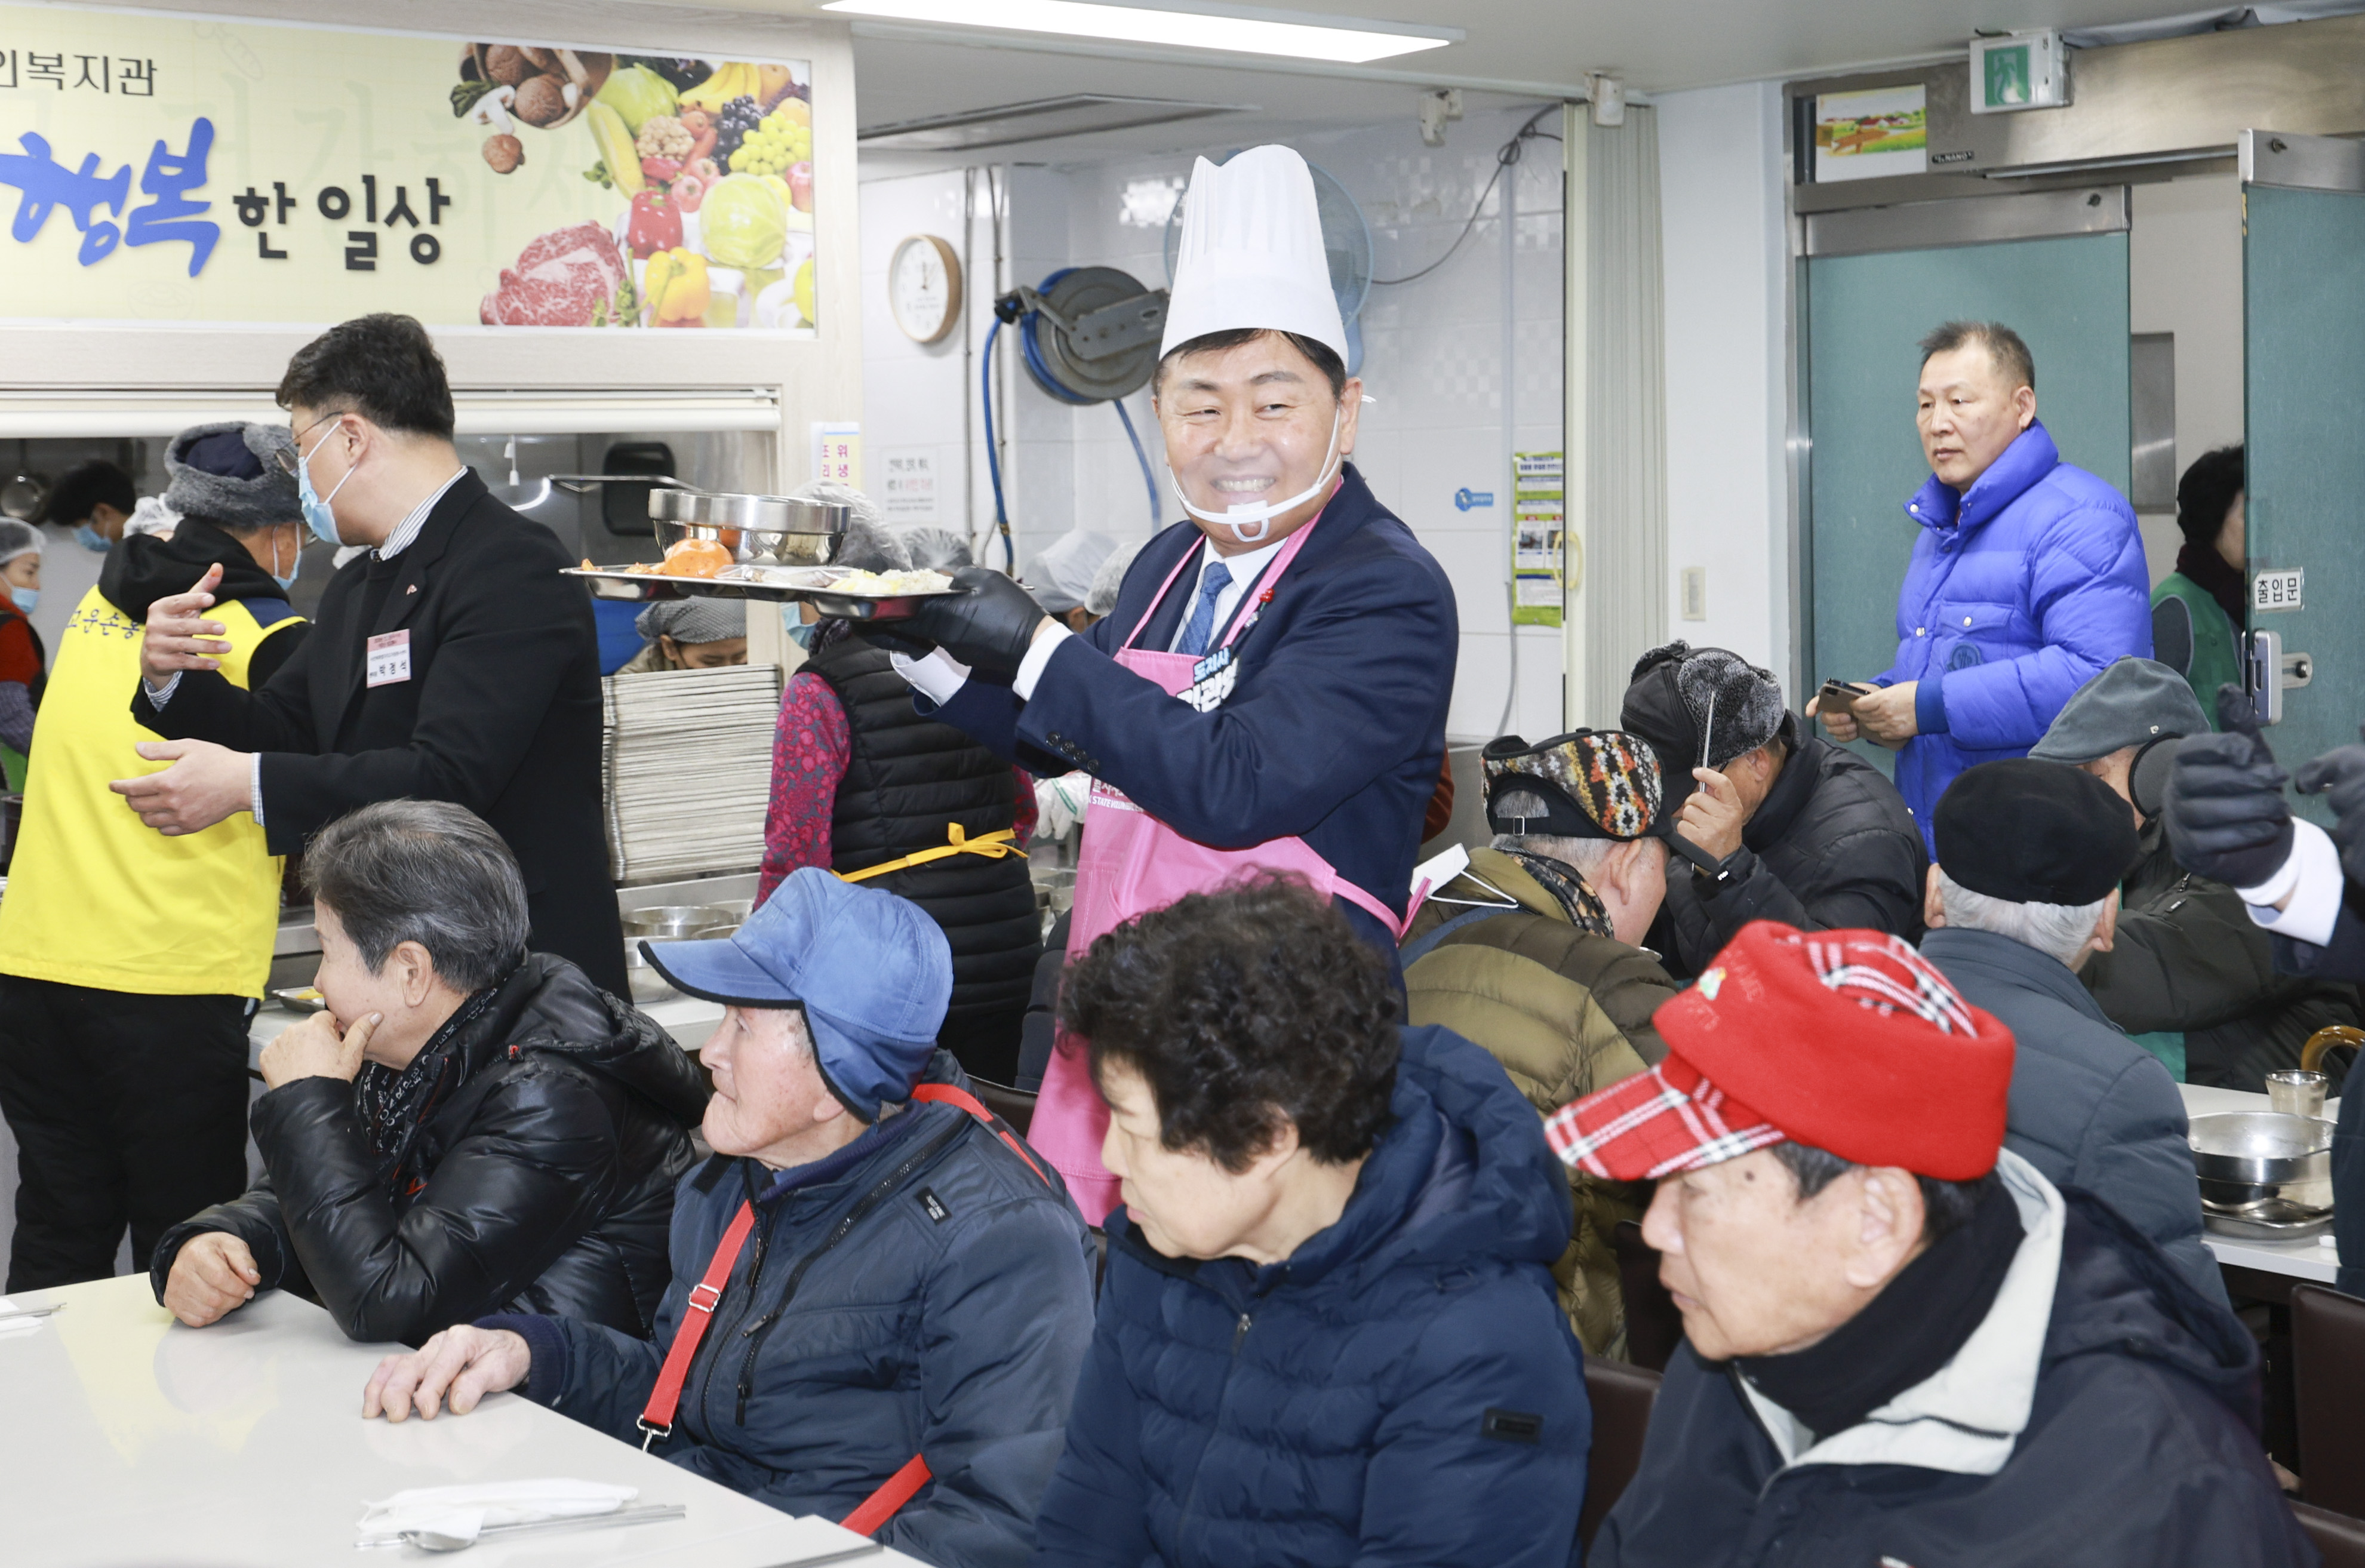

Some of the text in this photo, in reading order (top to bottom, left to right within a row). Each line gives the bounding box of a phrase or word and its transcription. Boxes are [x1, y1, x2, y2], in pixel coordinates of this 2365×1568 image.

[318, 174, 451, 271] 일상
[838, 444, 848, 486] 위생
[2258, 578, 2298, 603] 출입문
[67, 609, 146, 639] 고운손봉
[1194, 647, 1230, 682] 도지사
[1092, 796, 1111, 808] STATE
